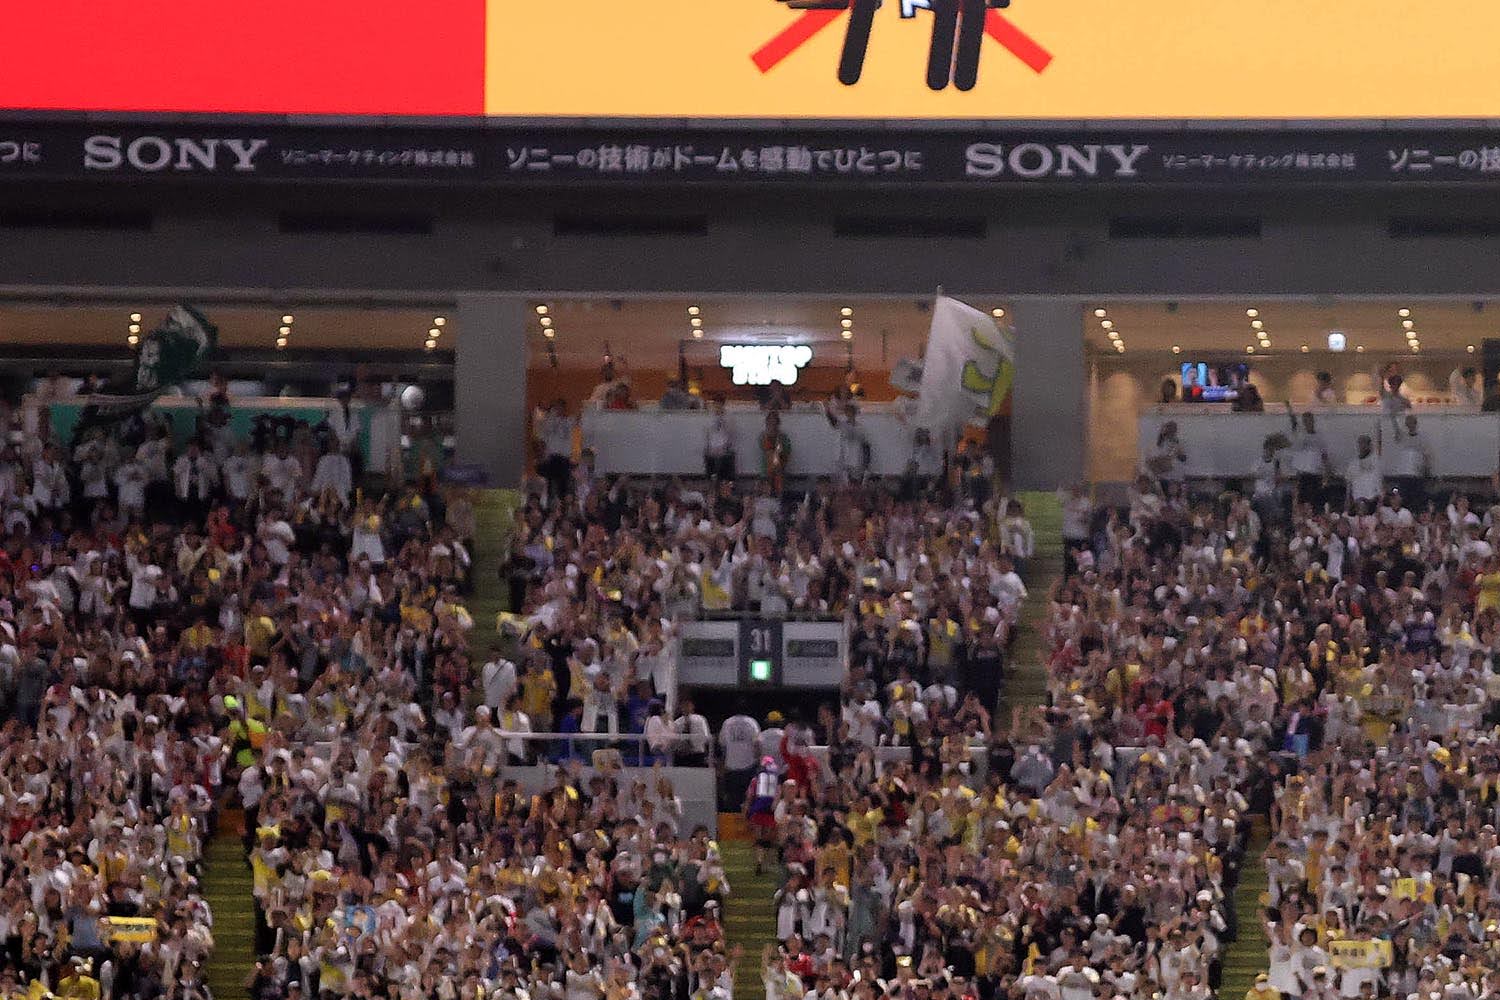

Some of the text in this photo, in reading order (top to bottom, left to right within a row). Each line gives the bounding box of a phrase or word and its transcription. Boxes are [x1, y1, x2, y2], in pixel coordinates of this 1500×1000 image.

[84, 136, 268, 171] SONY
[506, 145, 922, 172] ソニーの技術がドームを感動でひとつに
[965, 142, 1149, 177] SONY
[750, 628, 771, 651] 31
